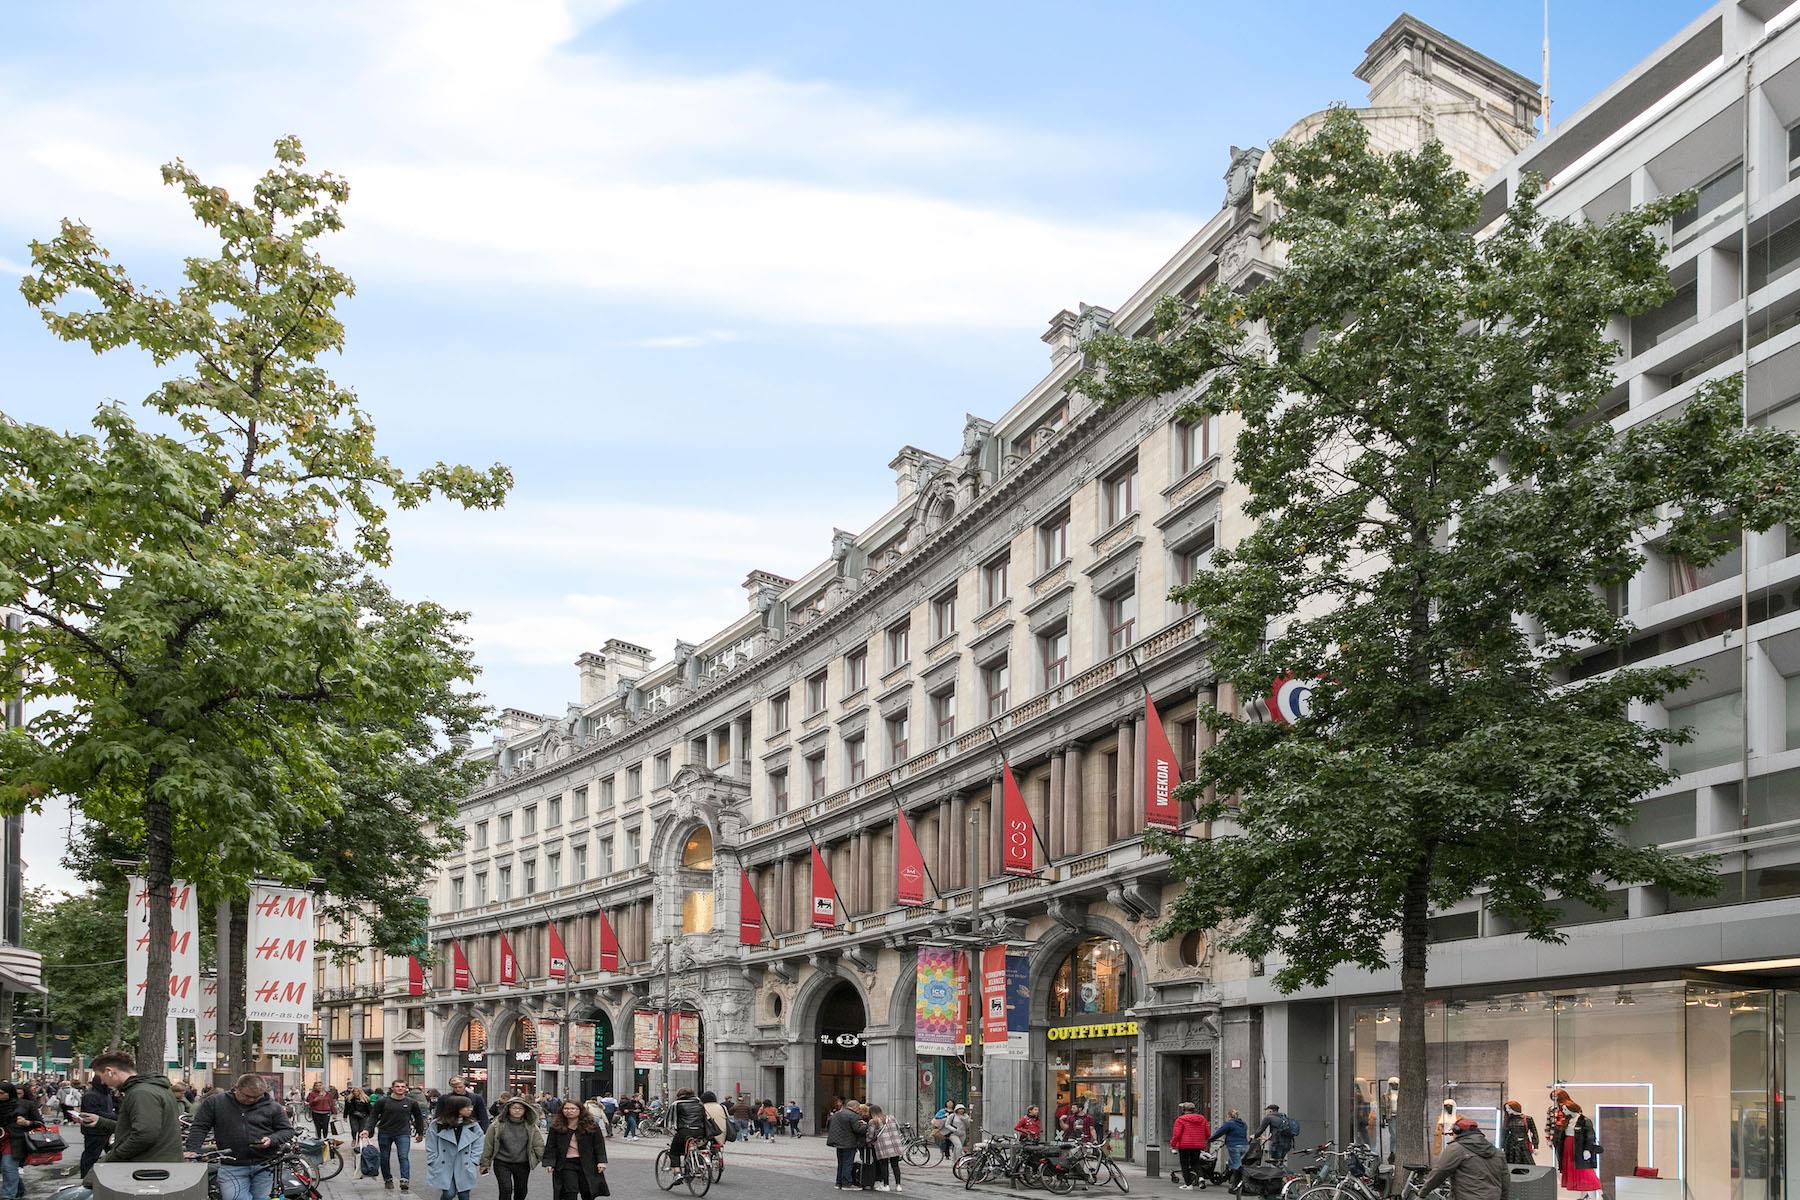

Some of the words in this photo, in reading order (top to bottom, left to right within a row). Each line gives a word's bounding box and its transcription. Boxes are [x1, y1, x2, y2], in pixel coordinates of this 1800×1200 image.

[1157, 759, 1169, 806] WEEKDAY
[1011, 820, 1027, 860] COS
[136, 887, 190, 911] HM
[255, 894, 307, 920] H&M
[136, 930, 191, 955] HM
[255, 937, 307, 962] H&M
[255, 979, 306, 1005] H&M
[250, 1010, 310, 1019] meir-as.be
